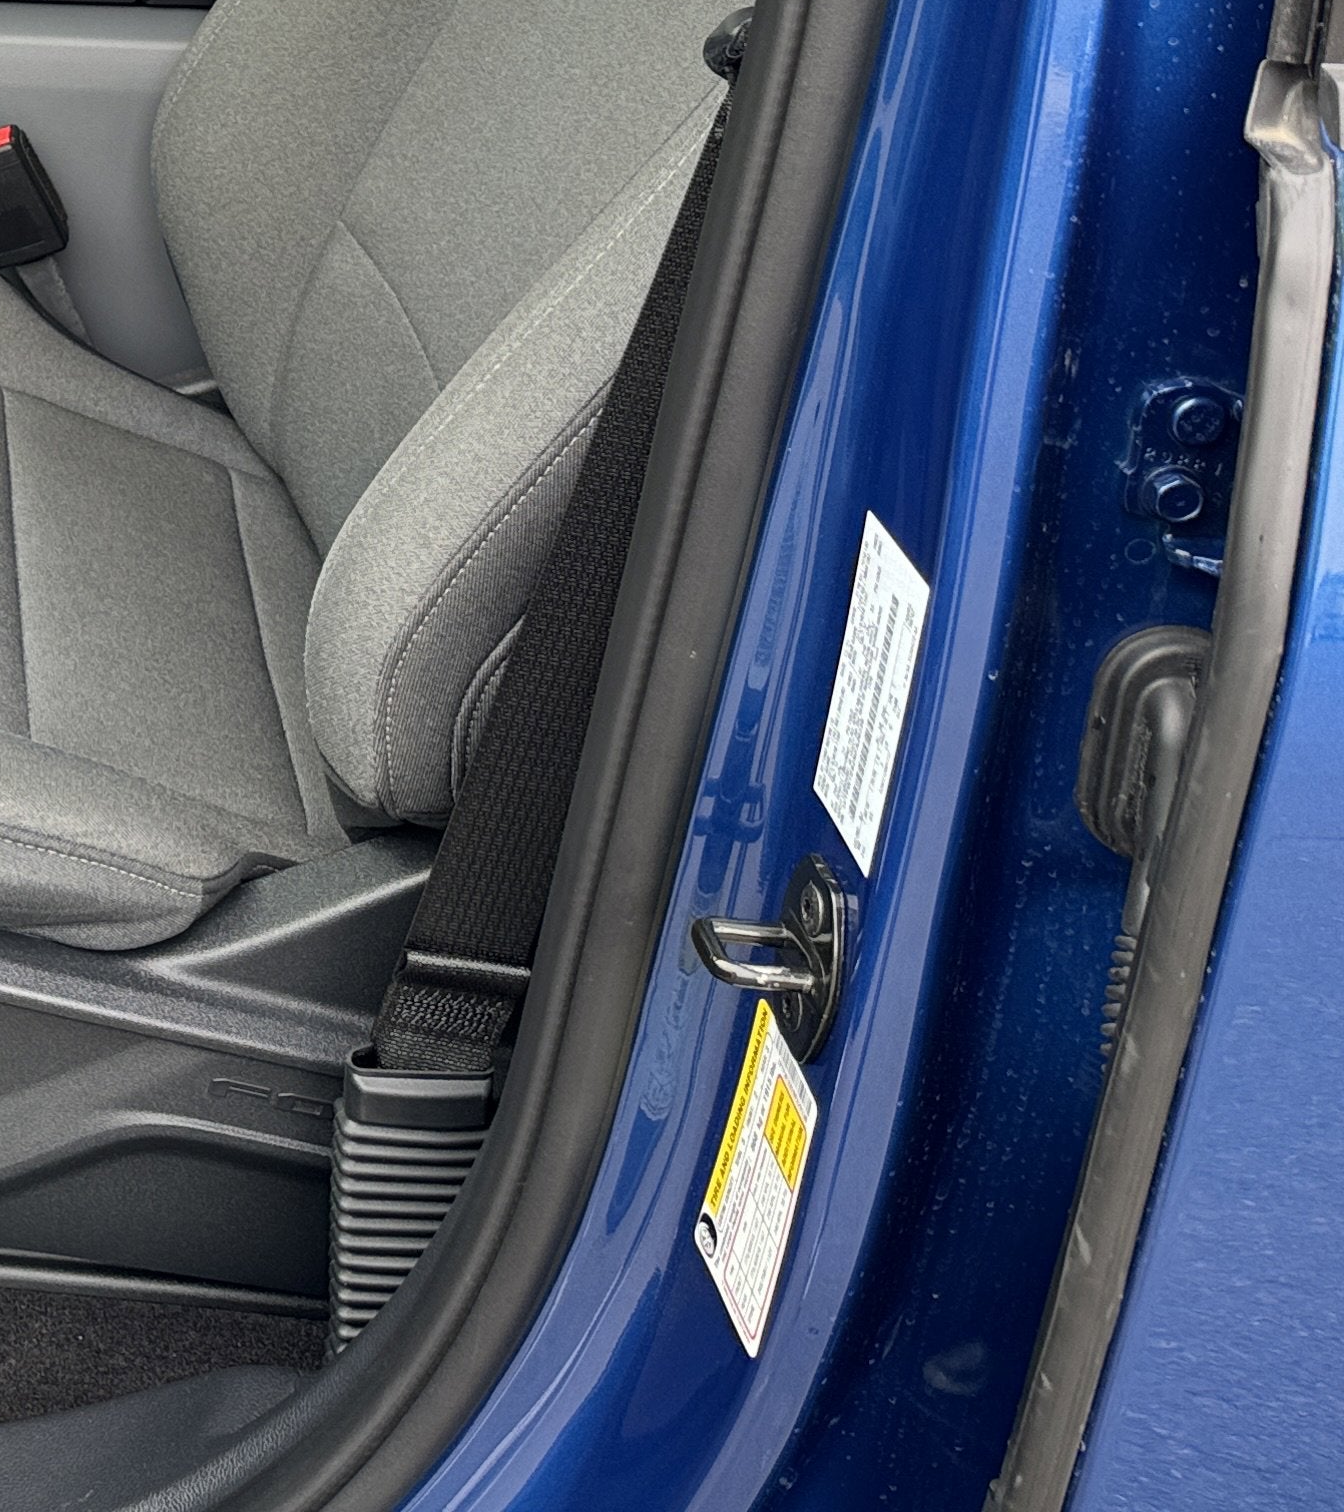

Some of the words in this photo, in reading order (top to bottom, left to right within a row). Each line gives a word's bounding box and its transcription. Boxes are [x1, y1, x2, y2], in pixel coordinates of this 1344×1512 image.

[710, 1176, 722, 1210] TIRE
[719, 1148, 729, 1179] AND
[726, 1092, 745, 1151] LOADING
[742, 1005, 768, 1096] INFORMATION
